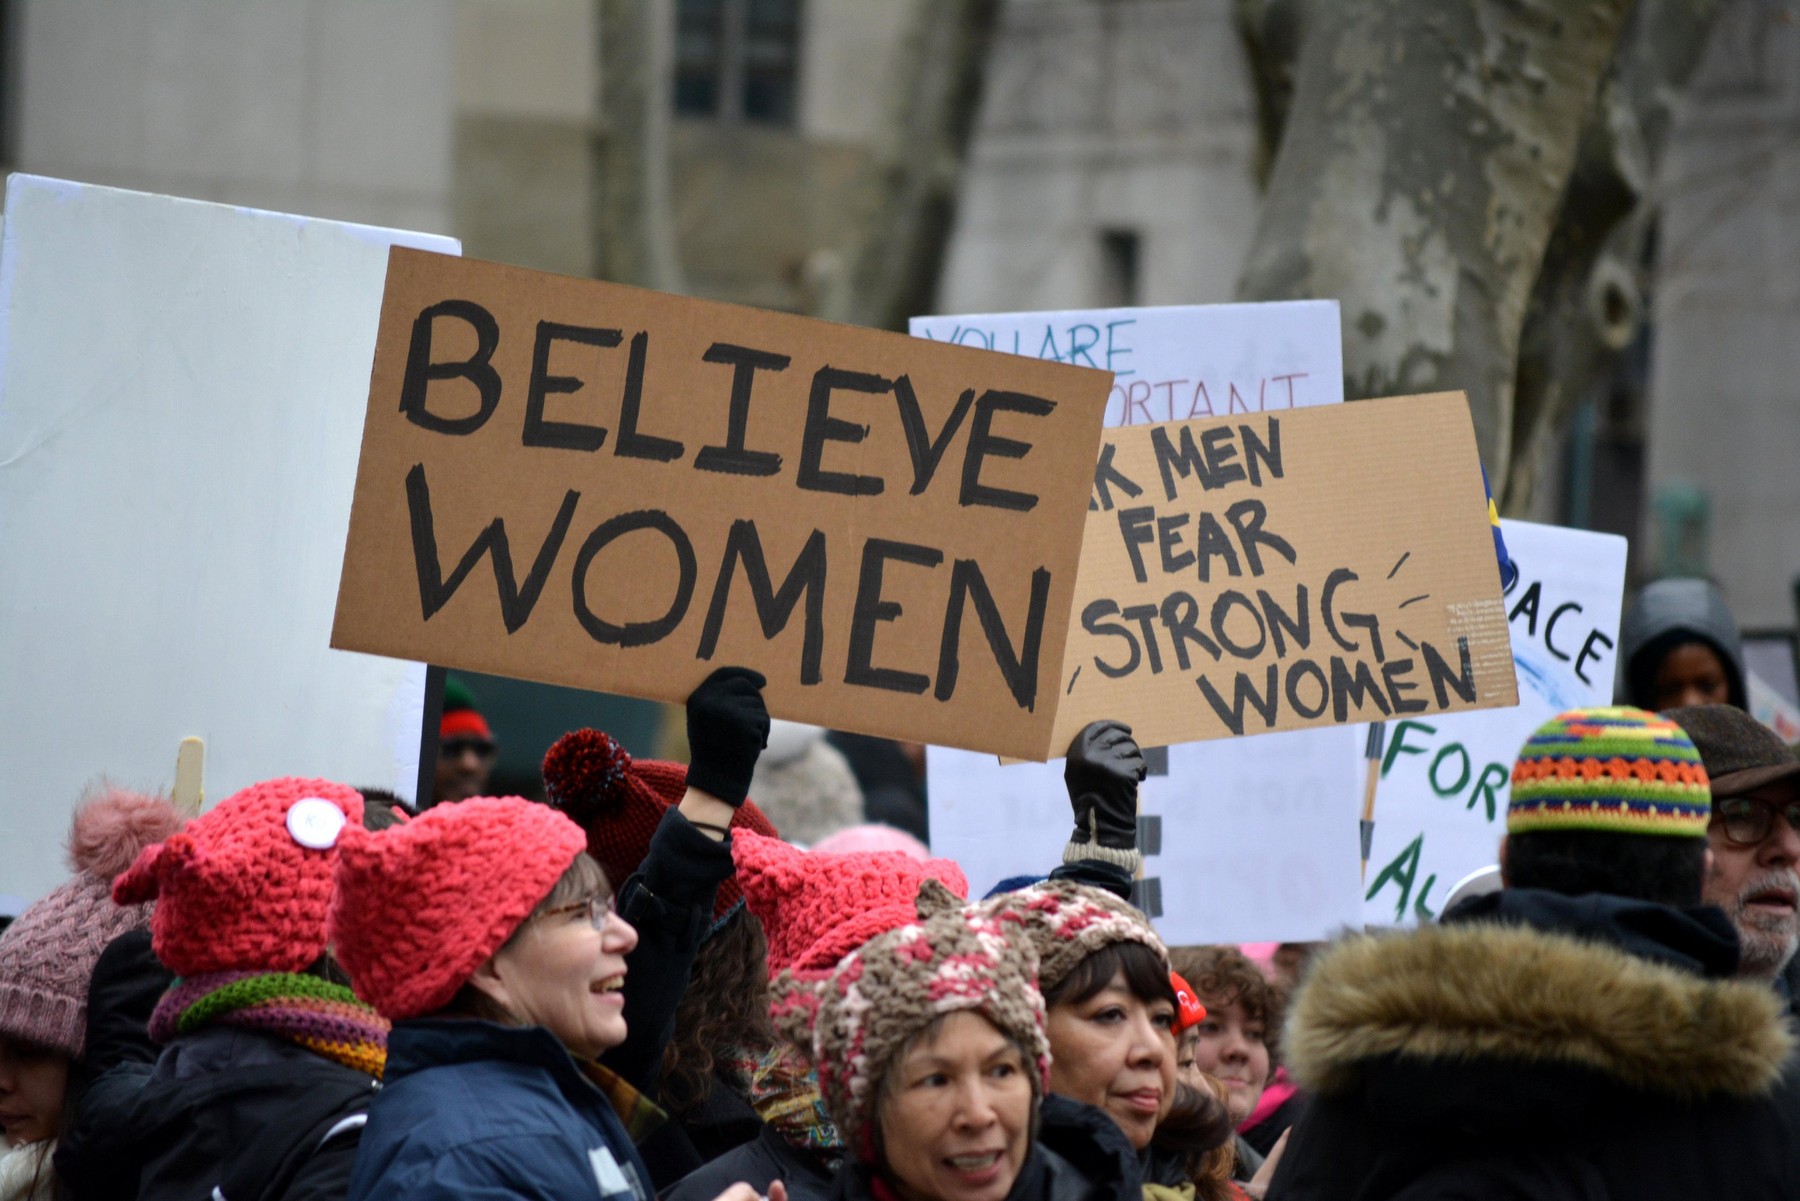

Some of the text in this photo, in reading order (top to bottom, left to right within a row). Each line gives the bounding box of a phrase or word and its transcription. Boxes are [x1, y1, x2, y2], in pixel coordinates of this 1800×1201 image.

[1039, 320, 1137, 376] ARE
[400, 300, 1058, 511] BELIEVE
[1150, 416, 1284, 501] MEN
[405, 463, 1051, 713] WOMEN
[1118, 498, 1297, 583] FEAR
[1081, 567, 1386, 678] STRONG
[1196, 636, 1476, 735] WOMEN
[1380, 720, 1510, 824] FOR
